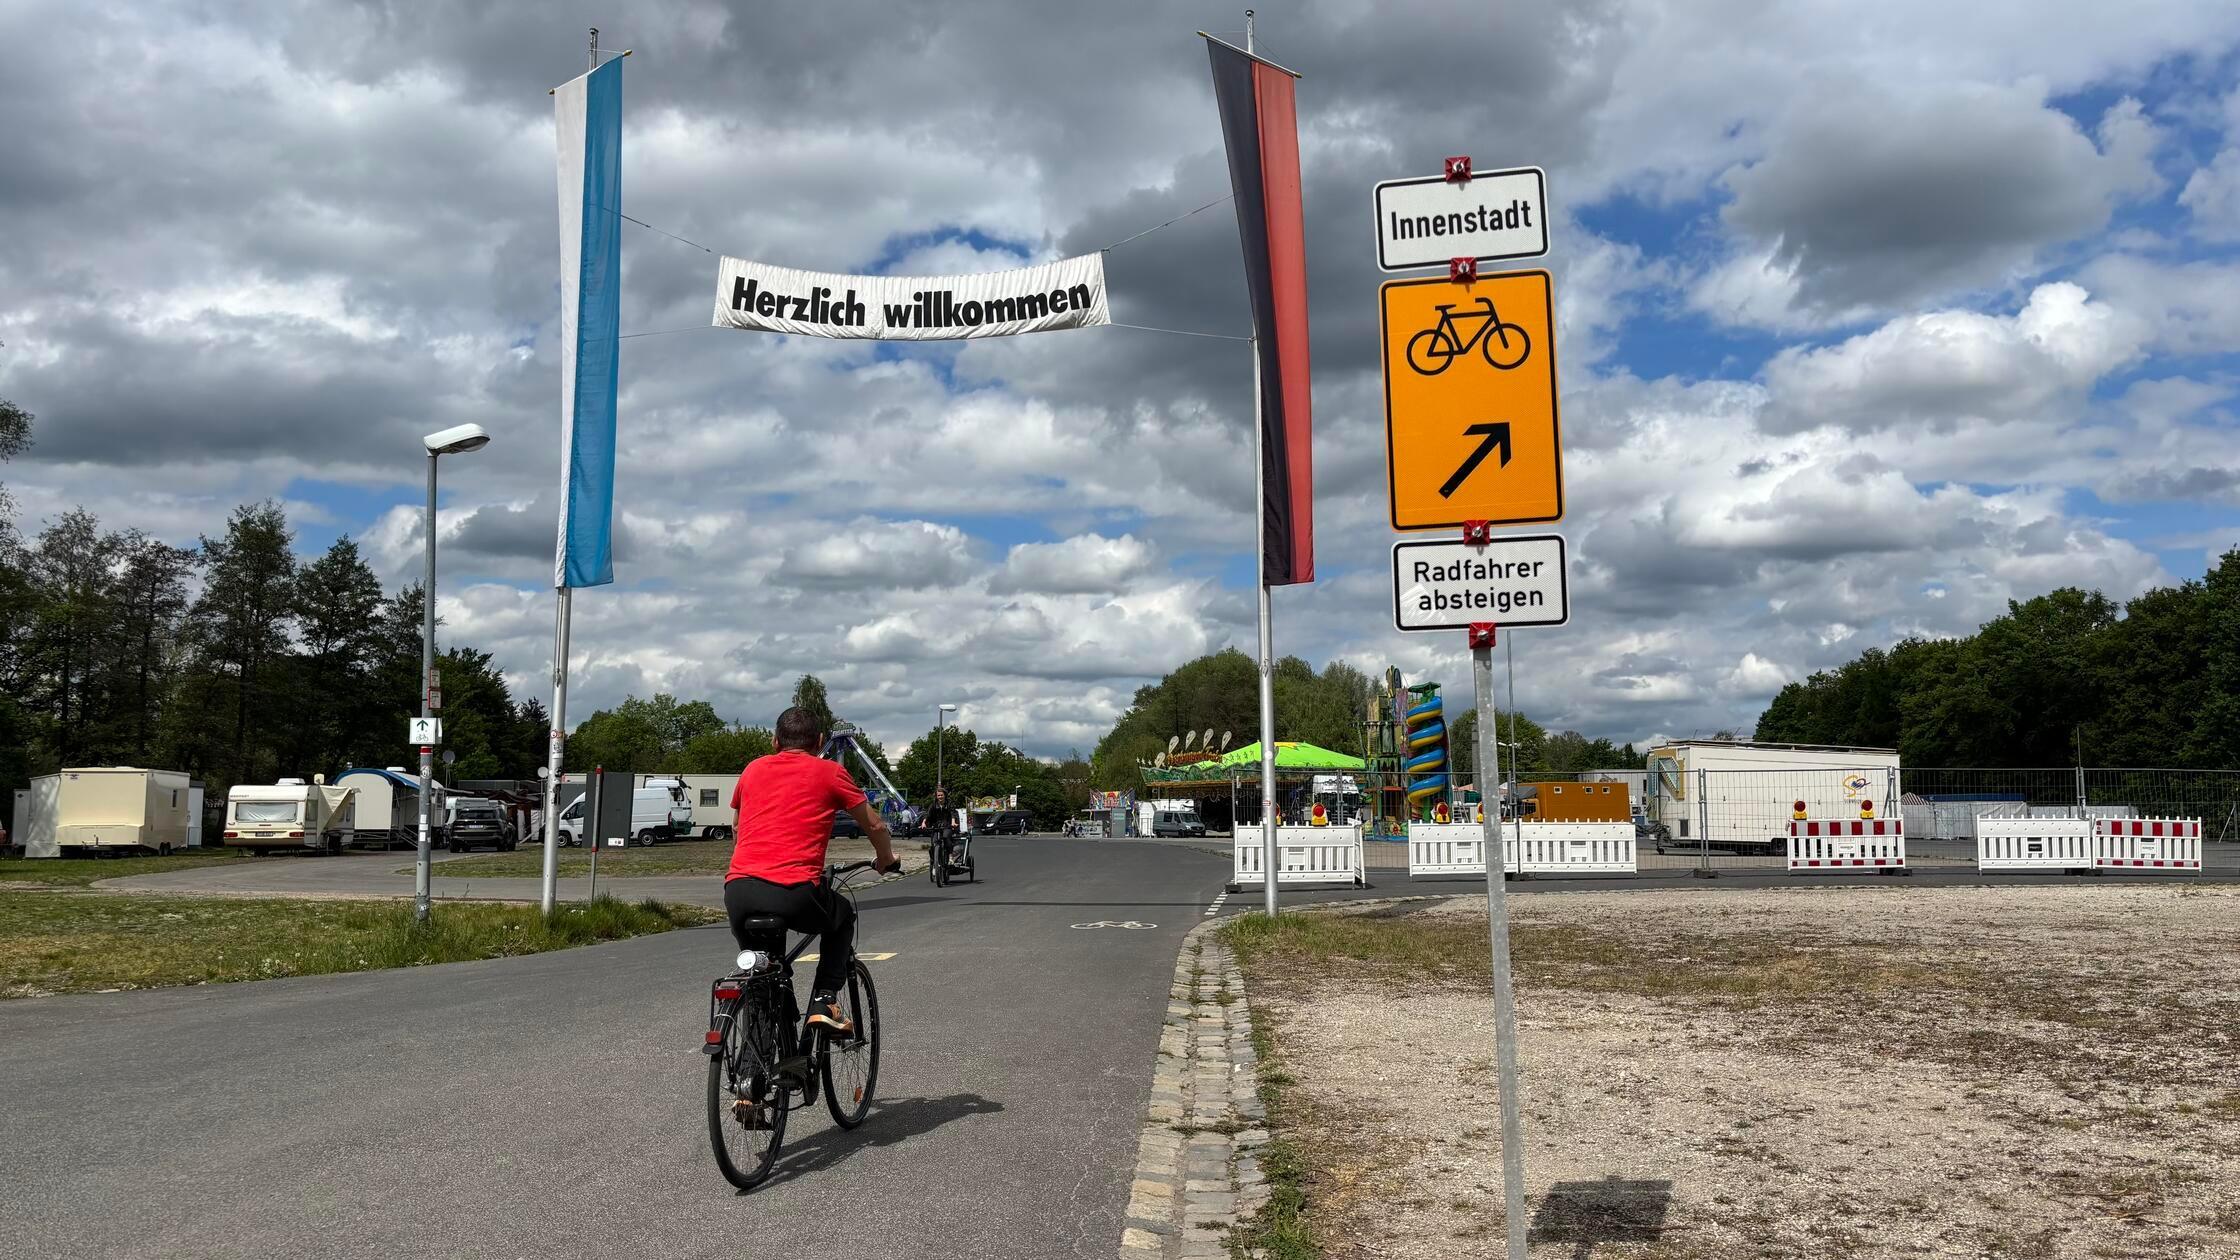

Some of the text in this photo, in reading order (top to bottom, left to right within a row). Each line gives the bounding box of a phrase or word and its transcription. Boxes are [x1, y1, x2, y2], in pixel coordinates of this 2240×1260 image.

[1391, 200, 1532, 240] Innenstadt
[732, 276, 1091, 328] Herzlich willkommen
[1414, 558, 1544, 582] Radfahrer
[1418, 587, 1543, 613] absteigen
